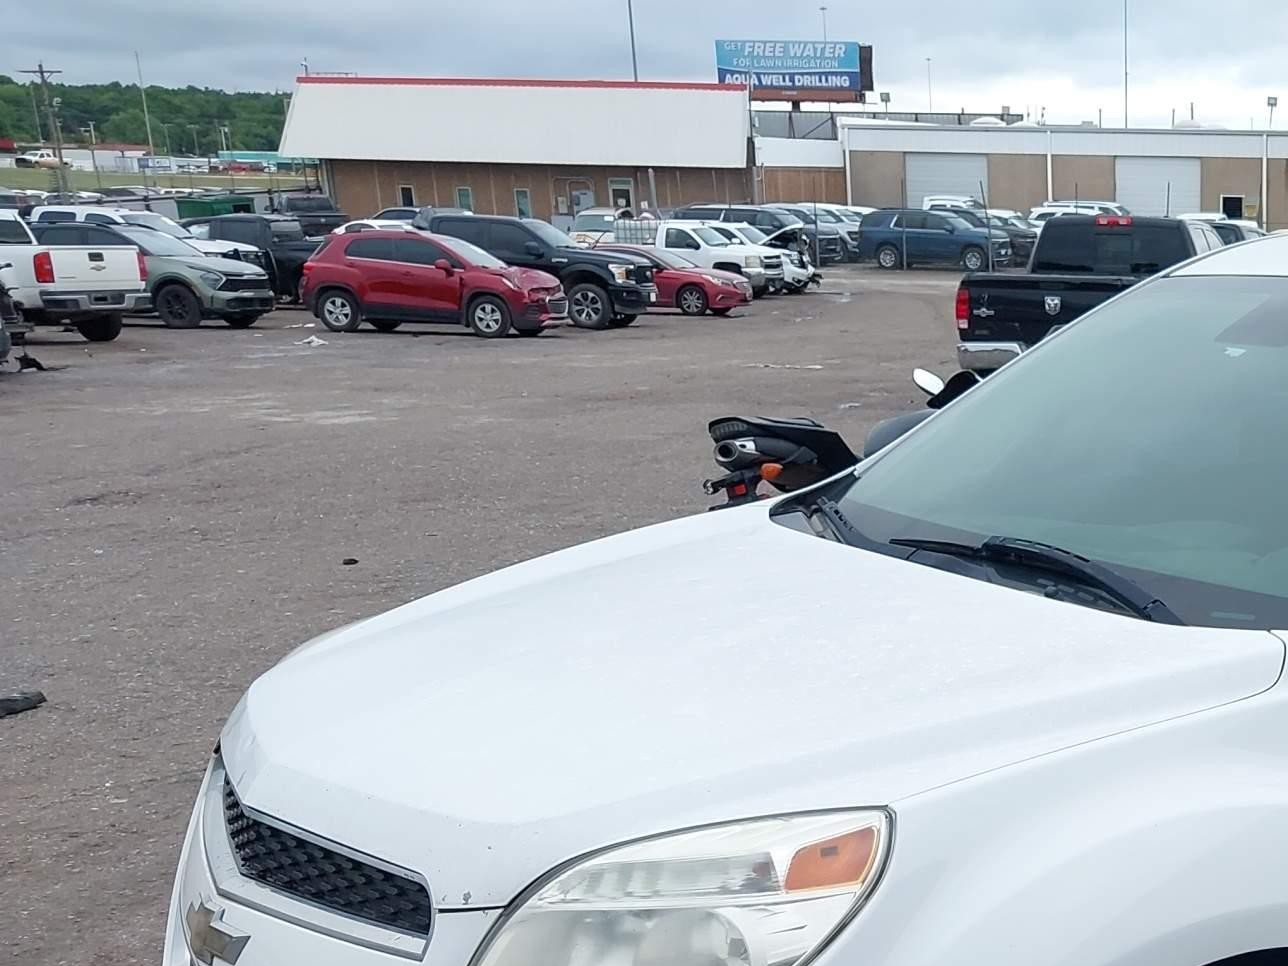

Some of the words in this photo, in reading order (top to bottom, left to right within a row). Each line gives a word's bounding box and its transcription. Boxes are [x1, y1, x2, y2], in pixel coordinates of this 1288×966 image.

[723, 42, 743, 50] GET
[744, 42, 785, 57] FREE
[789, 42, 846, 58] WATER
[733, 58, 751, 67] FOR
[754, 58, 782, 68] LAWN
[784, 59, 839, 68] IRRIGATION
[724, 73, 759, 86] AQUA
[760, 74, 793, 86] WELL
[794, 75, 850, 88] DRILLING
